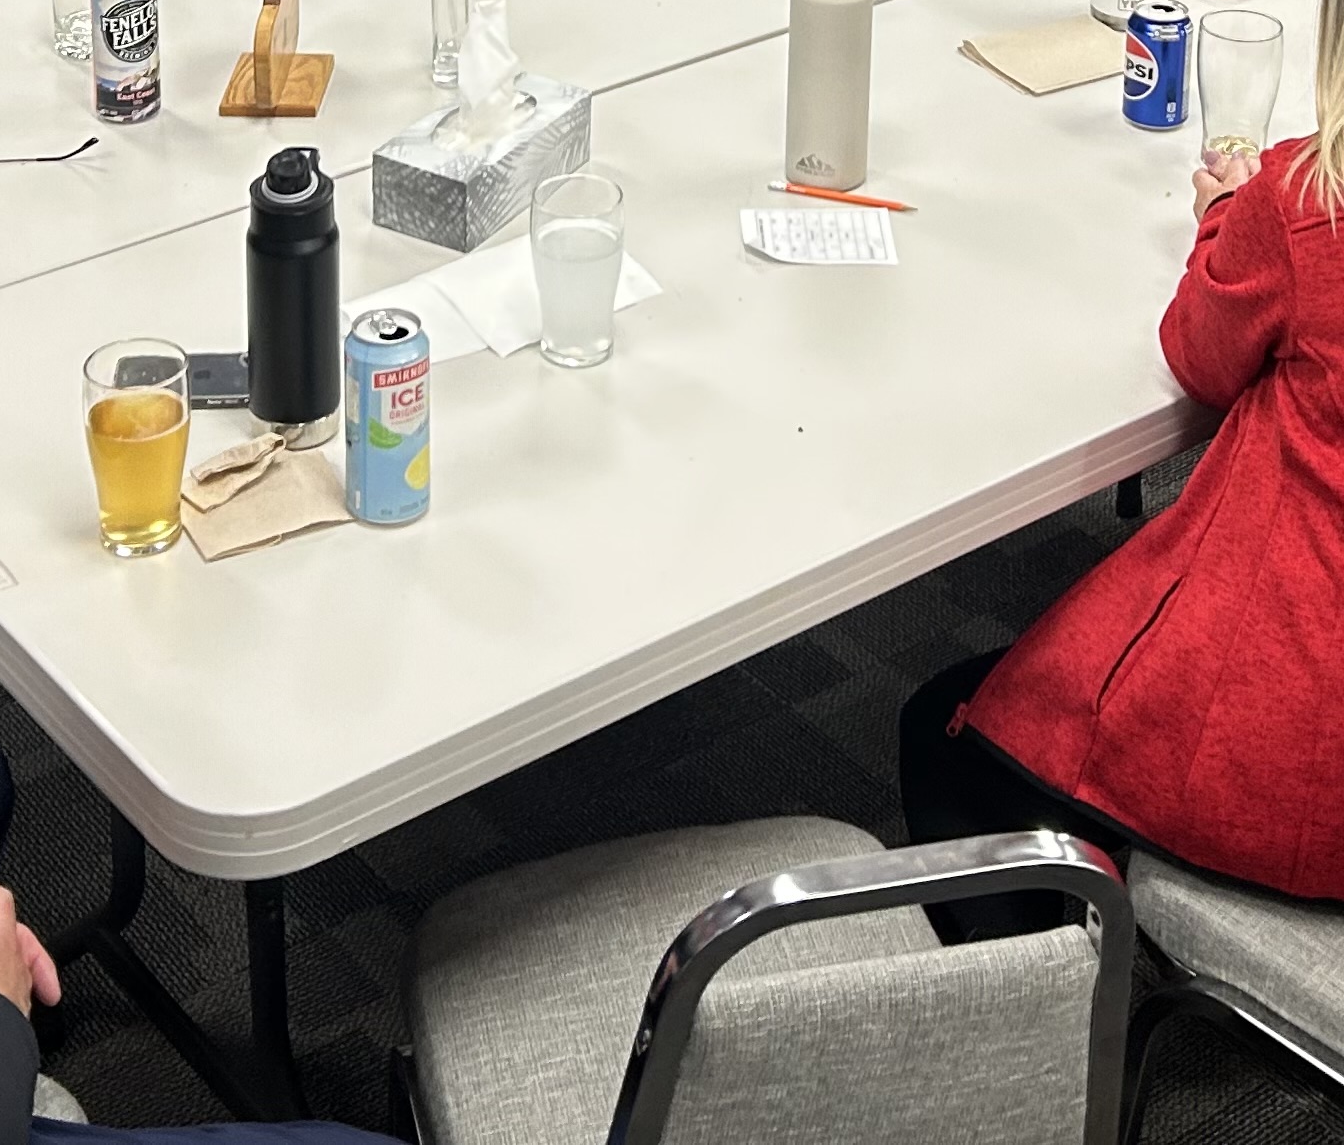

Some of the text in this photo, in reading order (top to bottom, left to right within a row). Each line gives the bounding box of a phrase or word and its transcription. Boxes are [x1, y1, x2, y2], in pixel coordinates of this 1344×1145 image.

[102, 1, 158, 33] FENELO
[113, 18, 158, 50] FALLS
[1126, 58, 1154, 81] PSI
[378, 359, 429, 387] SMIRNOF
[391, 382, 425, 411] ICE
